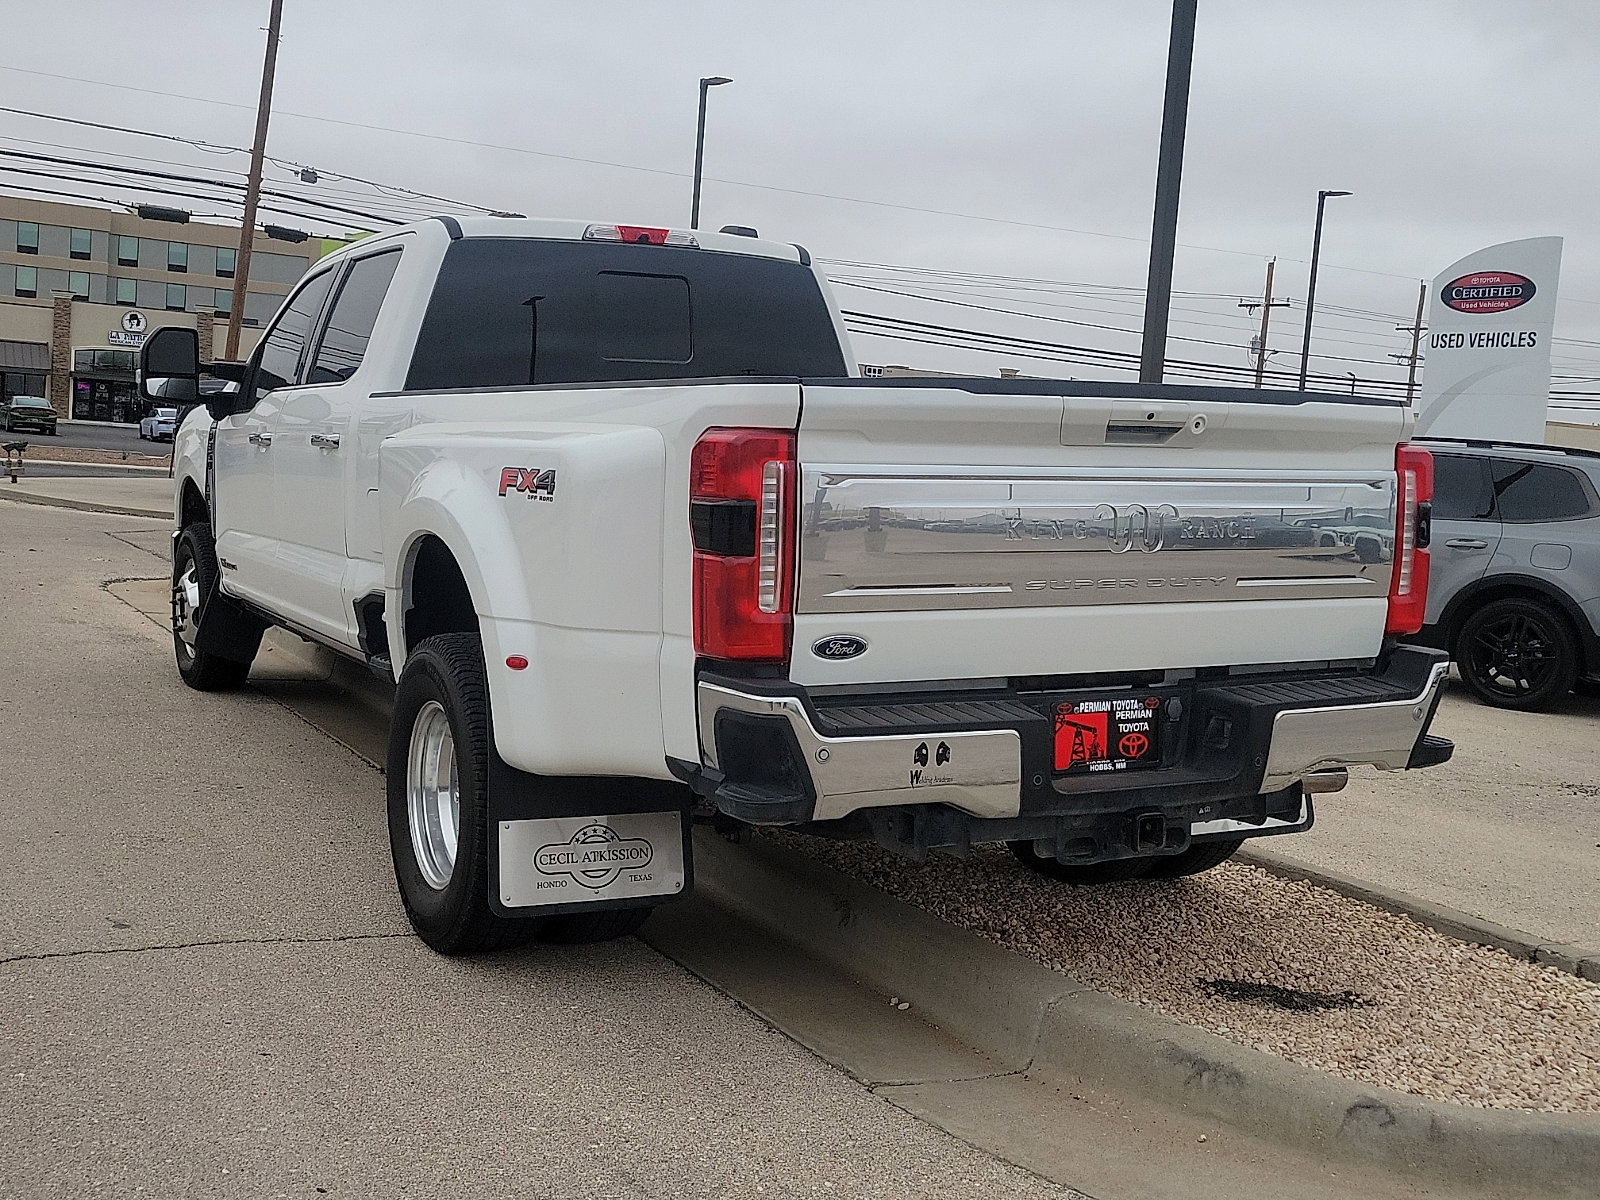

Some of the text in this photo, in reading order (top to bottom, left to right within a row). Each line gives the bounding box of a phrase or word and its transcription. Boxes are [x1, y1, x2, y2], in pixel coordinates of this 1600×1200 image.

[1479, 276, 1500, 284] TOYOTA
[1452, 286, 1523, 299] CERTIFIED
[1461, 301, 1478, 309] Used
[1430, 331, 1538, 349] USED VEHICLES
[499, 466, 556, 497] FX4
[1004, 514, 1257, 541] KING RANCH
[1025, 575, 1228, 591] SUPER DUTY
[825, 640, 857, 655] Ford
[1079, 699, 1139, 713] PERMIAN TOYOTA
[1115, 708, 1152, 720] PERMIAN
[1118, 721, 1149, 733] TOYOTA
[1090, 763, 1114, 771] HOBBS,
[1116, 761, 1127, 769] NM
[539, 847, 650, 866] CECIL ATKISSION
[537, 873, 653, 889] HONDO TEXAS
